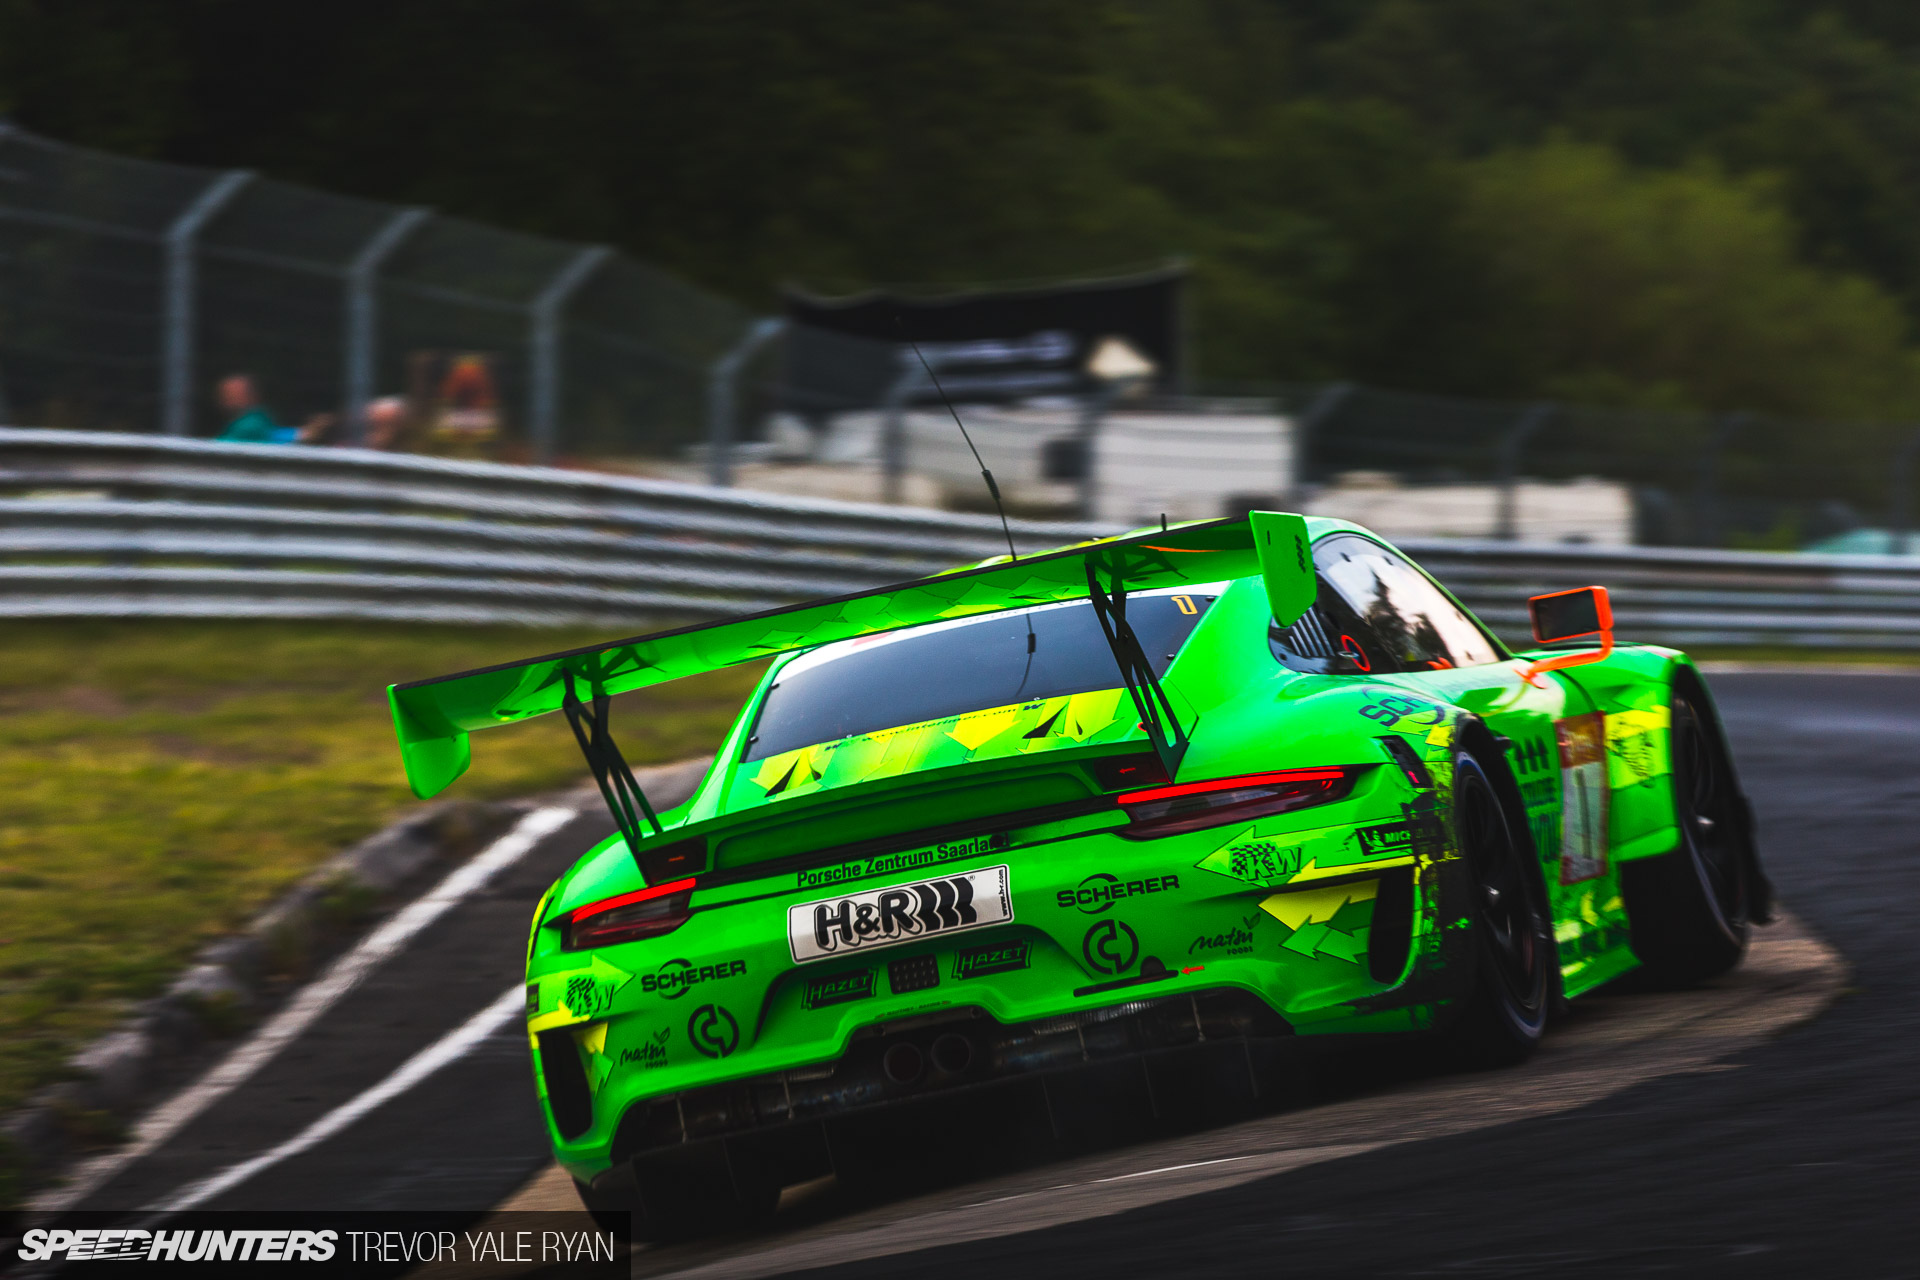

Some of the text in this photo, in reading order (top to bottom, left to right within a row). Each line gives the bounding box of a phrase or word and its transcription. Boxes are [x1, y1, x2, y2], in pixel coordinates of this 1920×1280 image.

[796, 861, 861, 887] Porsche
[863, 849, 934, 875] Zentrum
[1245, 846, 1302, 882] KW
[1056, 875, 1180, 908] SCHERER
[814, 889, 923, 953] H&R
[641, 959, 747, 993] SCHERER
[961, 946, 1025, 972] HAZET
[810, 975, 870, 1001] HAZET
